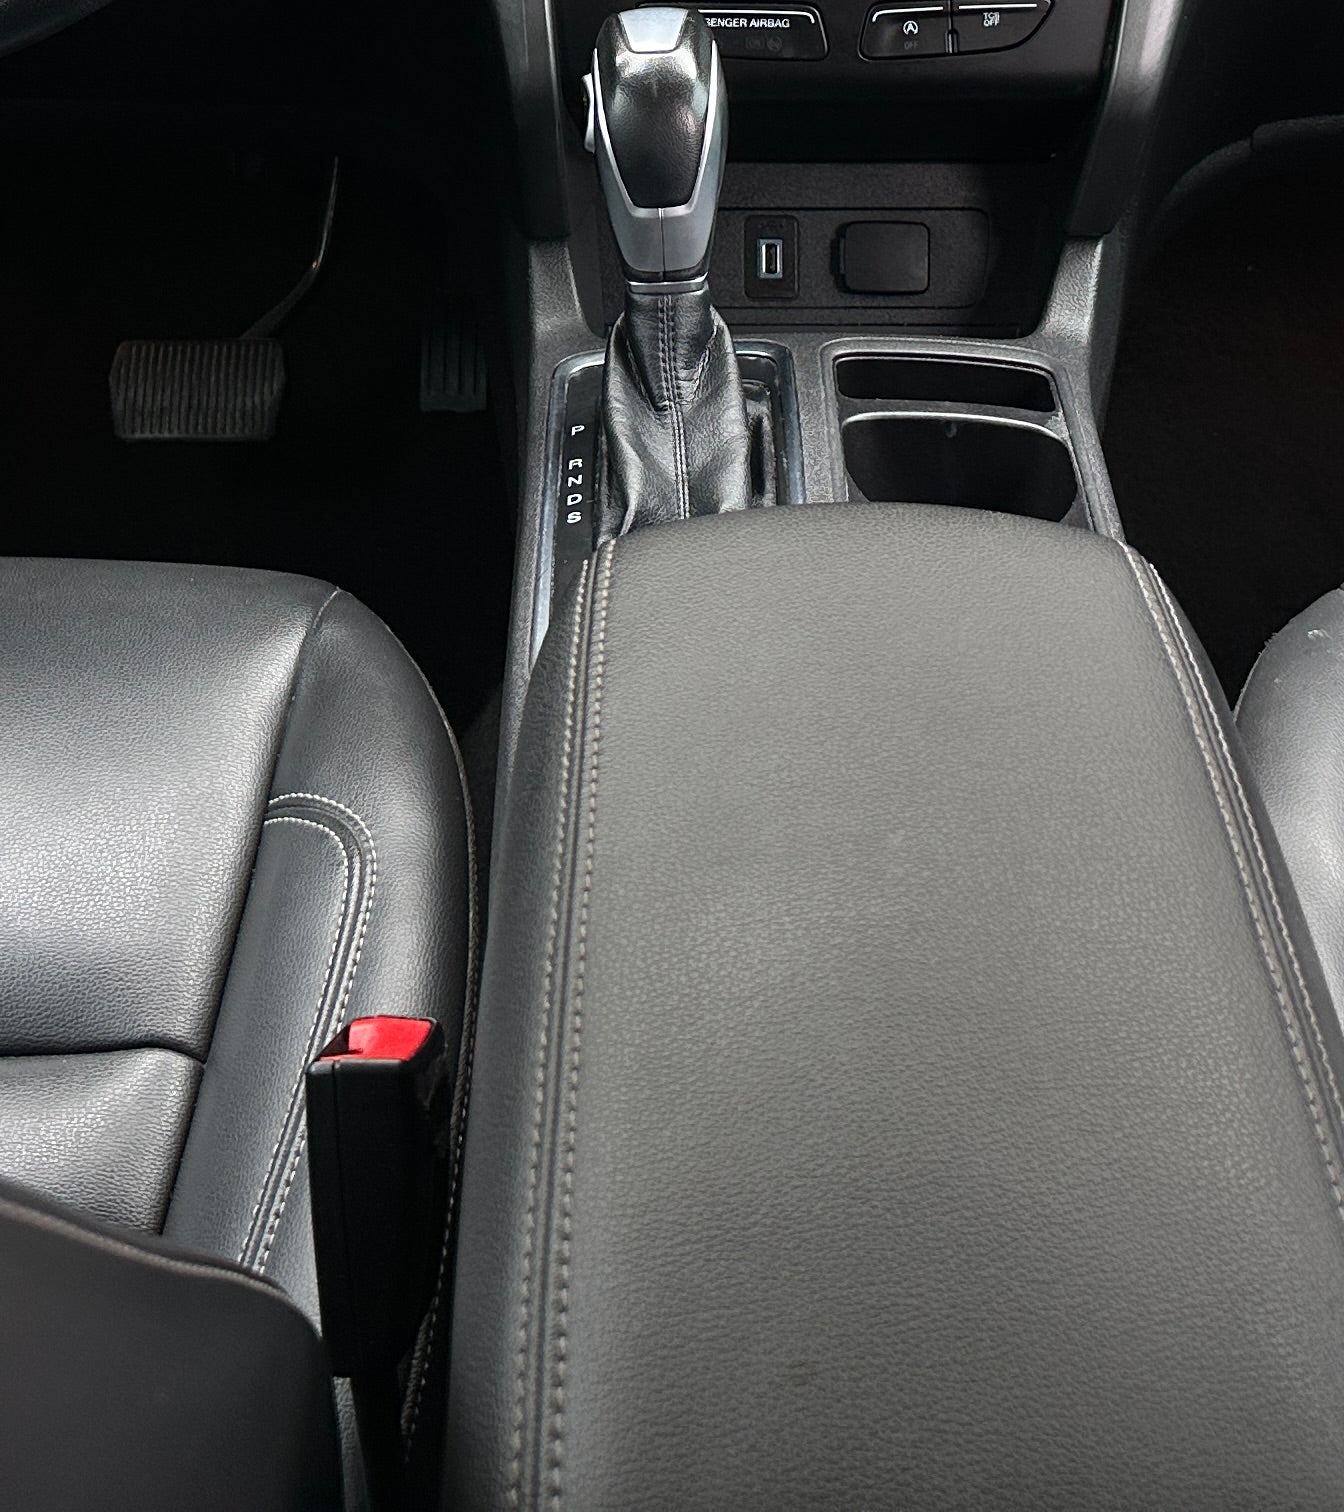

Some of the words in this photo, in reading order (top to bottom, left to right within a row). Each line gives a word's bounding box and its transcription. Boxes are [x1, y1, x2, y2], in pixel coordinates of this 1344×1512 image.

[749, 18, 790, 28] AIRBAG
[570, 424, 585, 437] P
[568, 458, 583, 471] R
[567, 474, 583, 488] N
[566, 493, 583, 506] D
[566, 511, 582, 524] S
